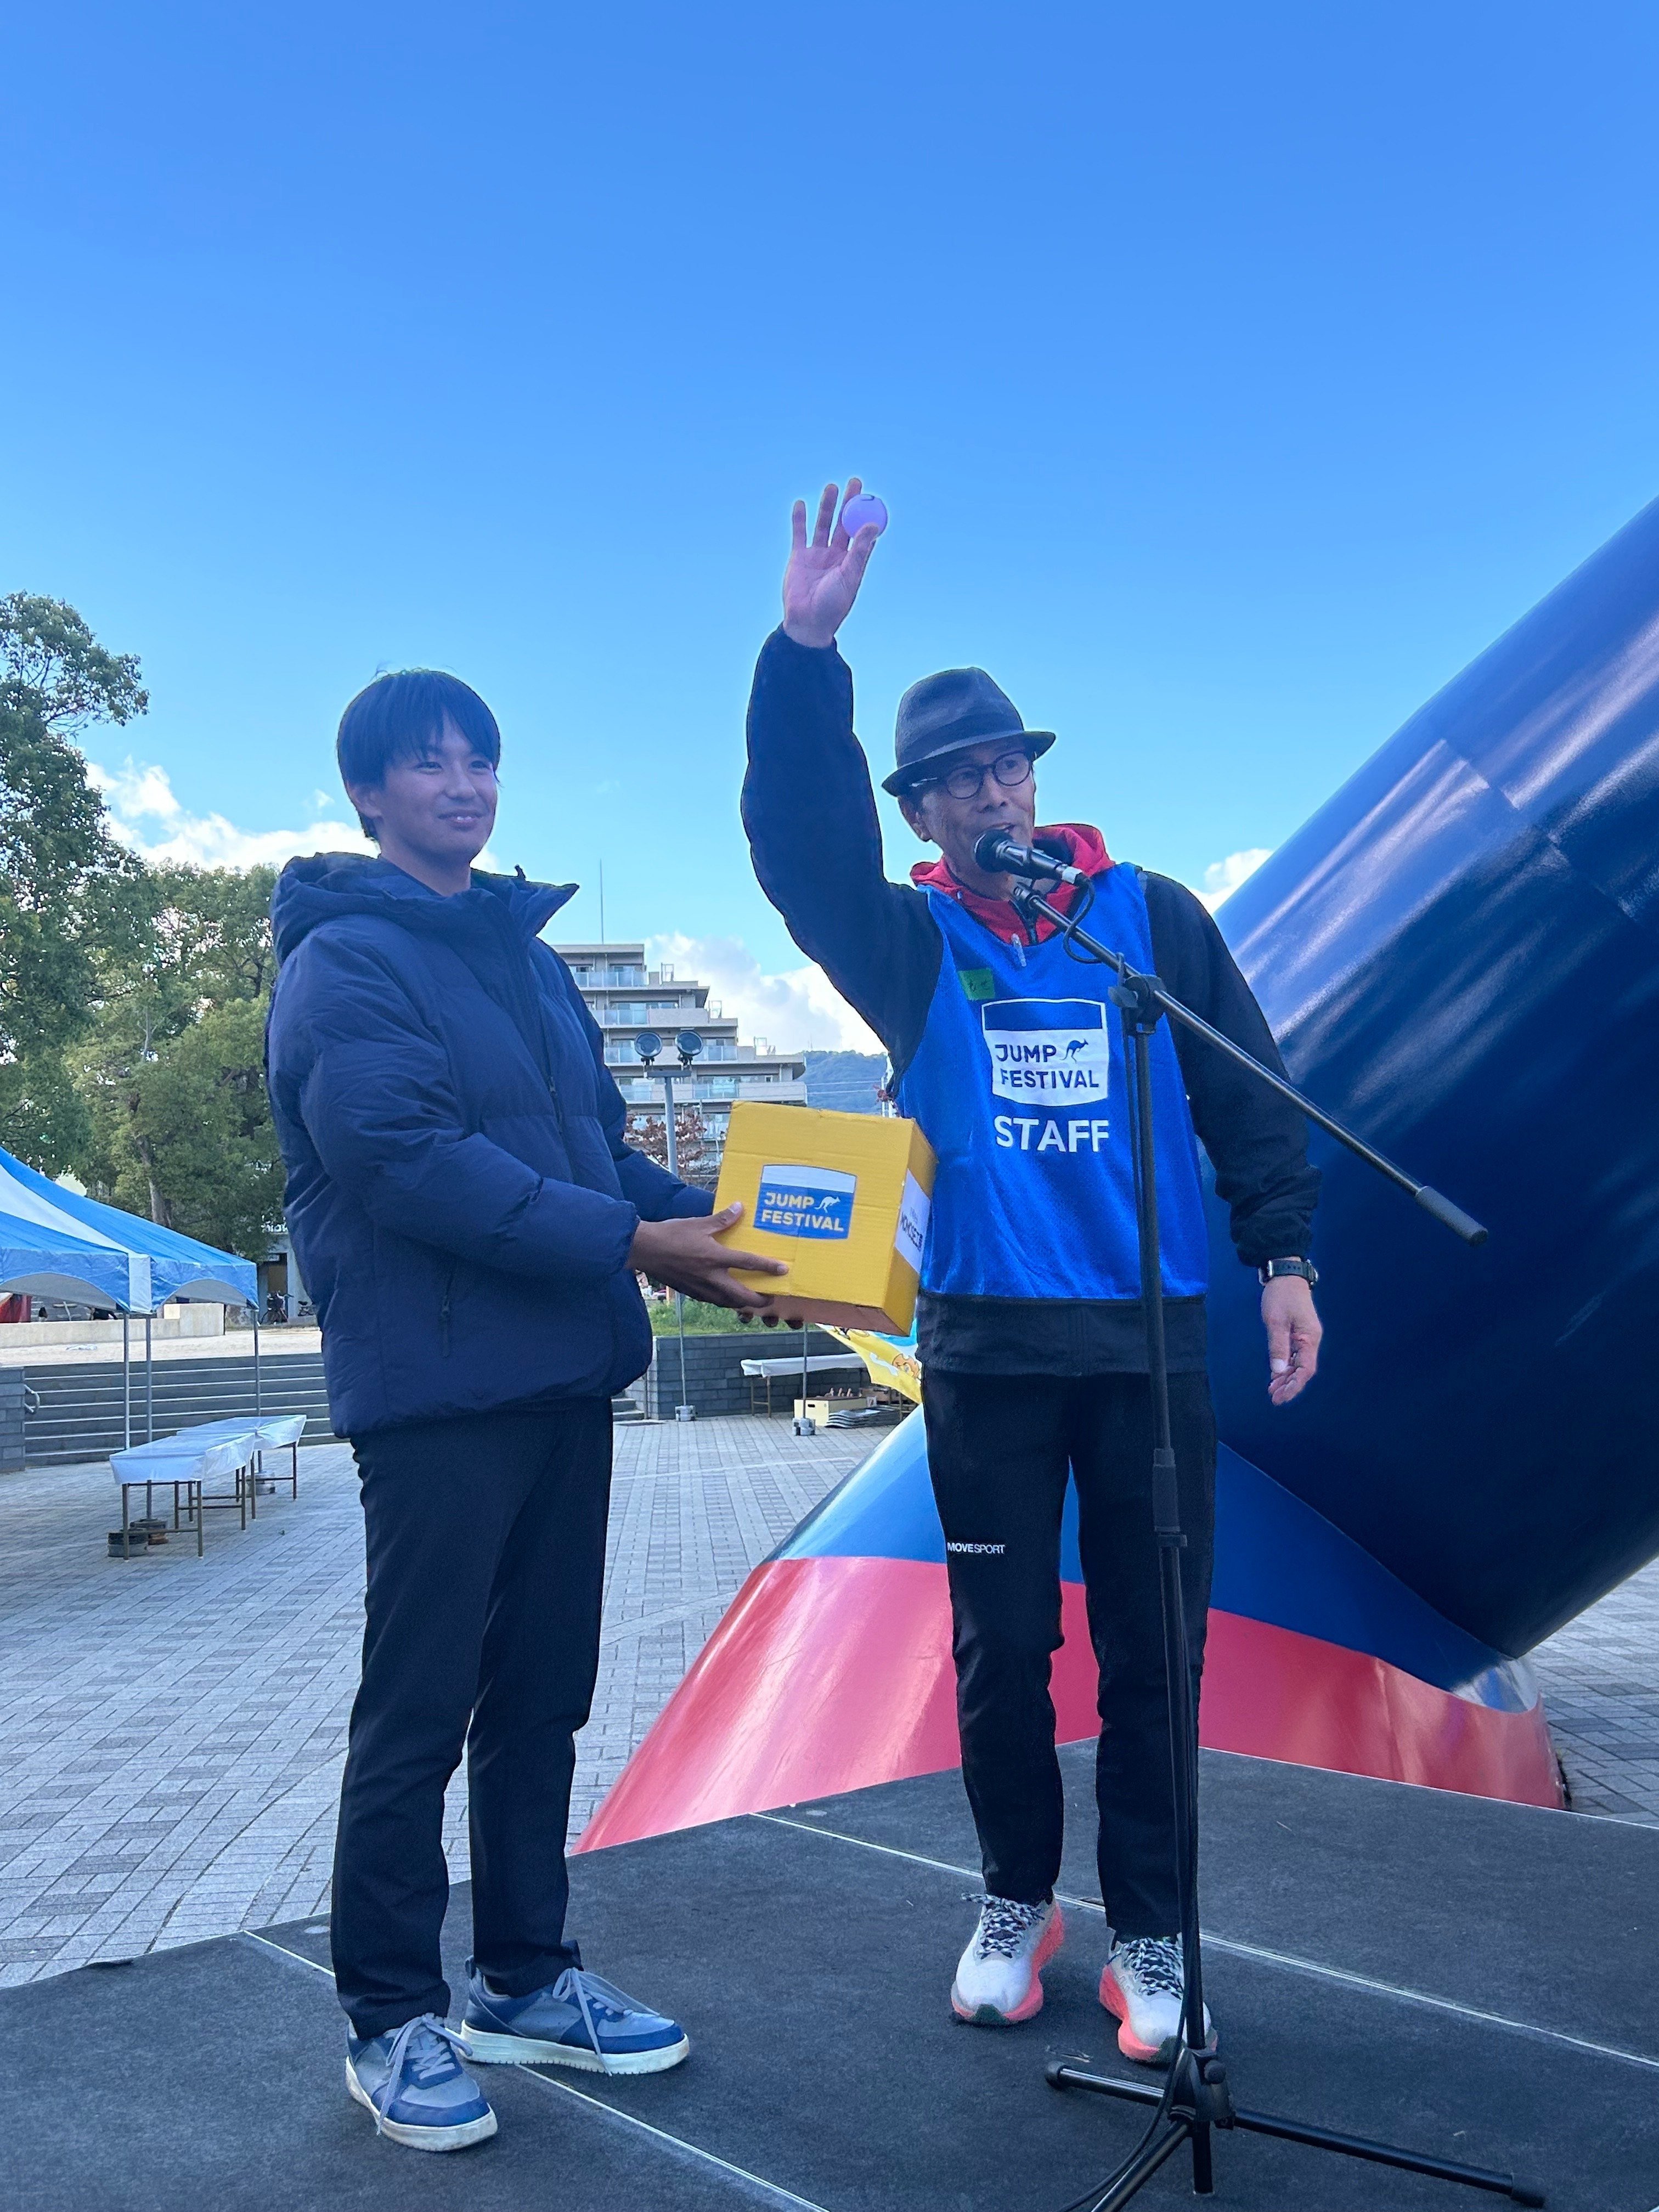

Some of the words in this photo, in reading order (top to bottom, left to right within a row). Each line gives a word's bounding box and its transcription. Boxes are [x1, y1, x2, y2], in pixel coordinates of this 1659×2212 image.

[995, 1044, 1057, 1063] JUMP
[1001, 1069, 1099, 1089] FESTIVAL
[994, 1115, 1109, 1153] STAFF
[764, 1192, 815, 1209] JUMP
[761, 1210, 844, 1232] FESTIVAL
[947, 1542, 1006, 1554] MOVESPORT
